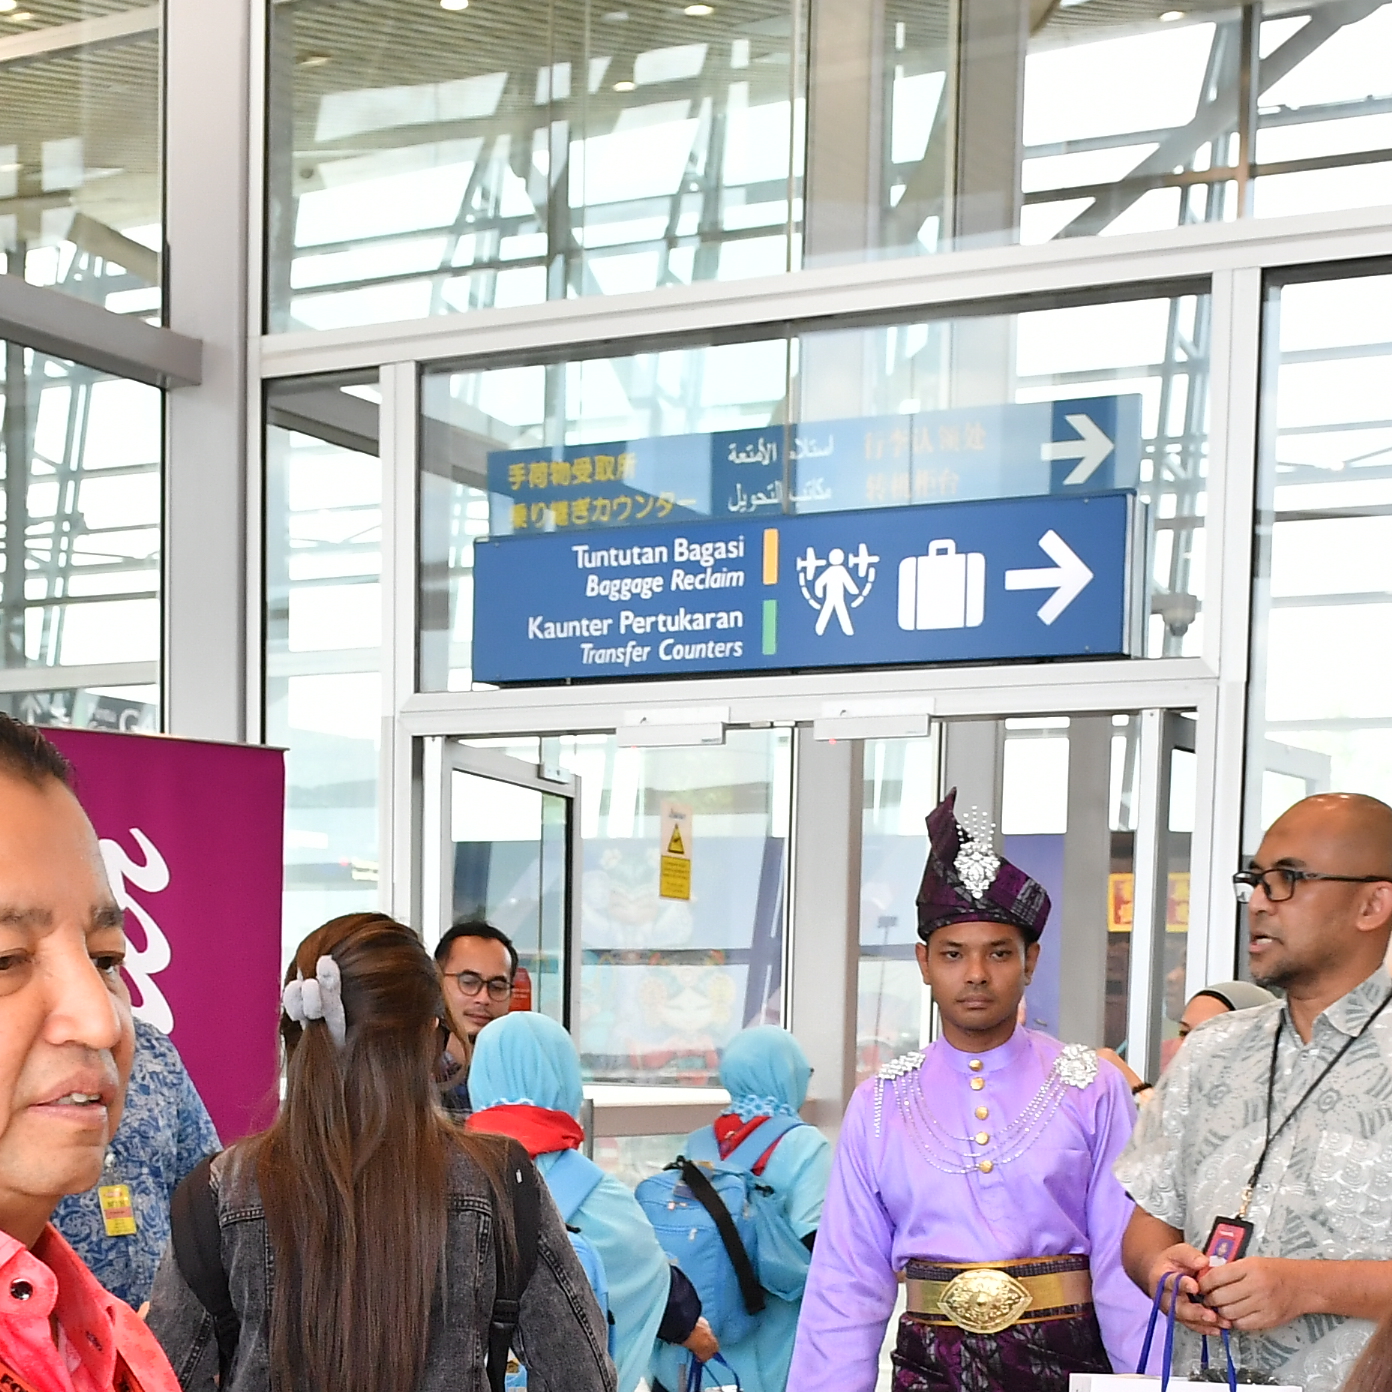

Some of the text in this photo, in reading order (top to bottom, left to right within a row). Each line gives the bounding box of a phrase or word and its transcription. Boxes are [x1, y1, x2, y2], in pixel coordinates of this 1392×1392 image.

[571, 535, 745, 569] Tuntutan Bagasi
[586, 567, 745, 601] Baggage Reclaim
[528, 607, 743, 640] Kaunter Pertukaran
[580, 638, 743, 667] Transfer Counters
